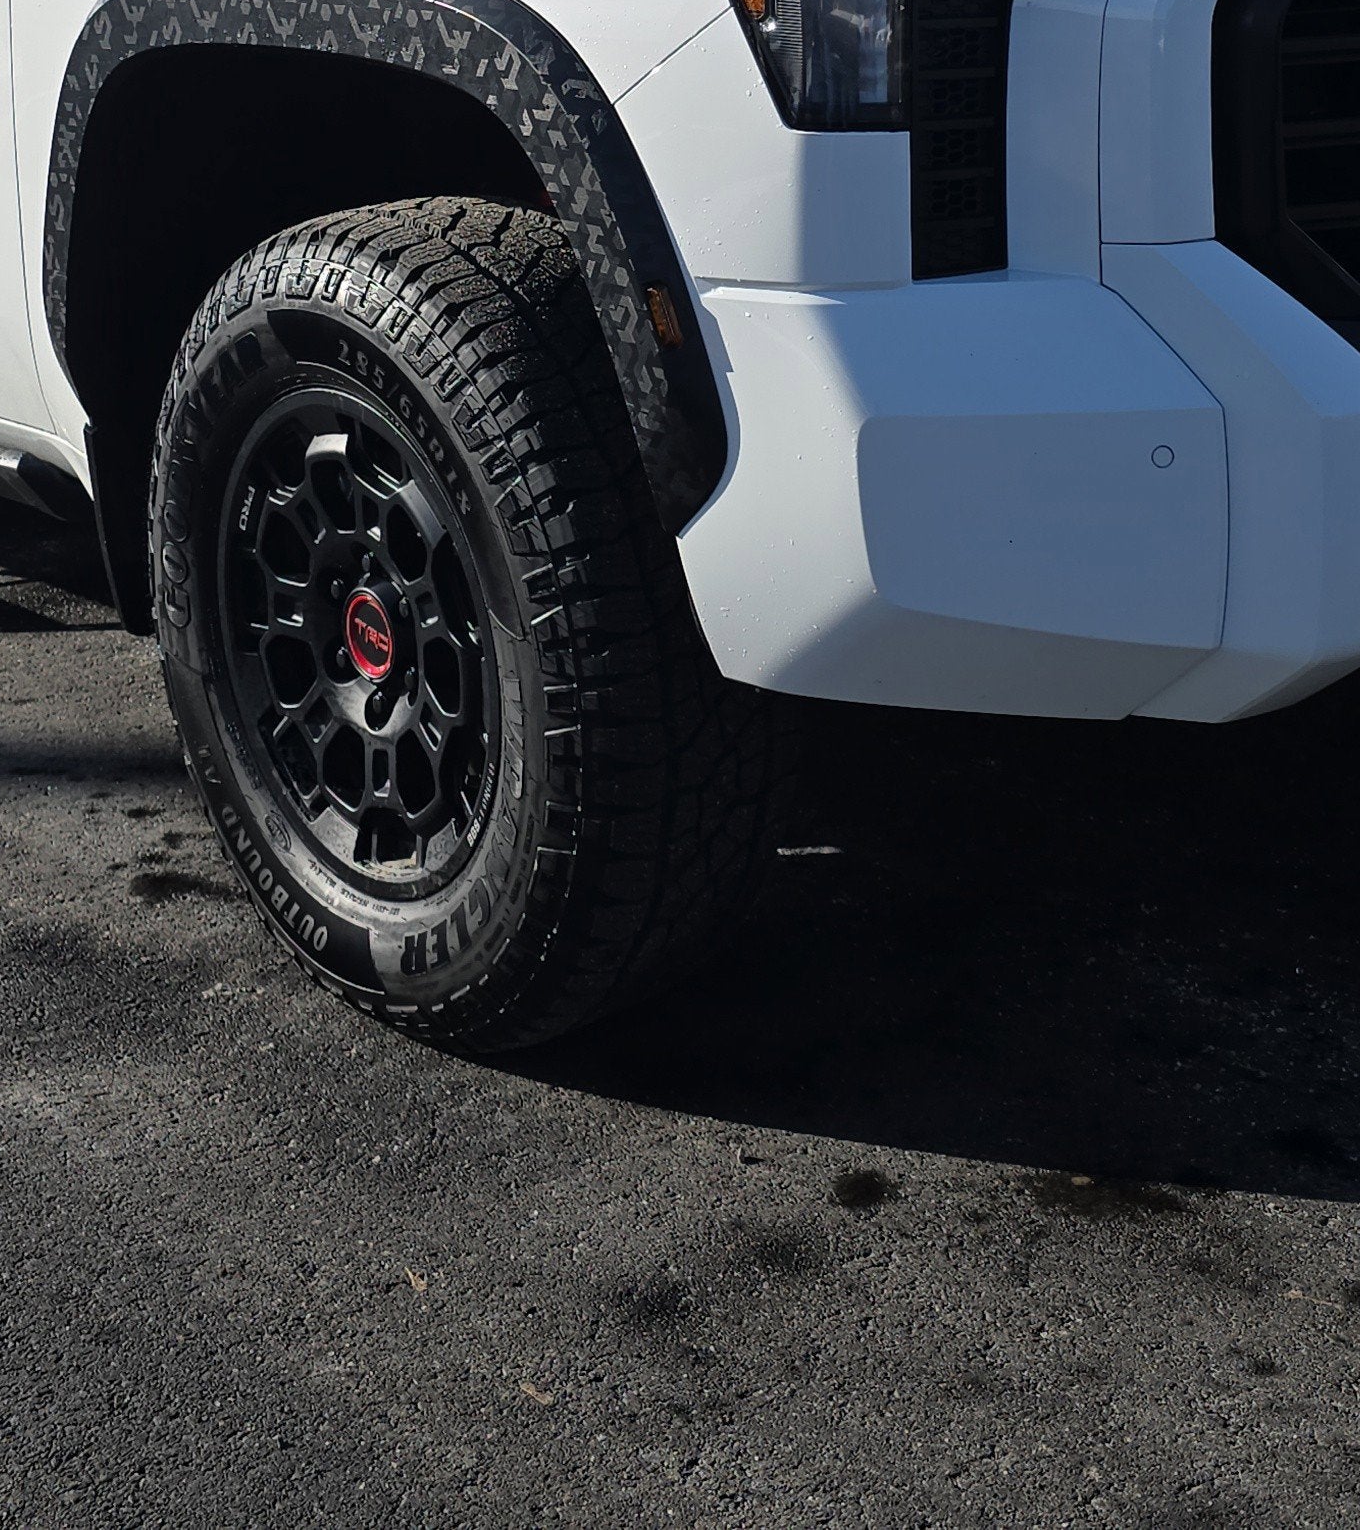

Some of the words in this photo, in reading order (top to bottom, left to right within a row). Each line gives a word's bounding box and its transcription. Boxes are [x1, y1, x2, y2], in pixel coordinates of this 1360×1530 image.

[239, 485, 256, 531] PRO
[221, 802, 329, 952] OUTBOUND
[400, 676, 525, 977] WRANGLER
